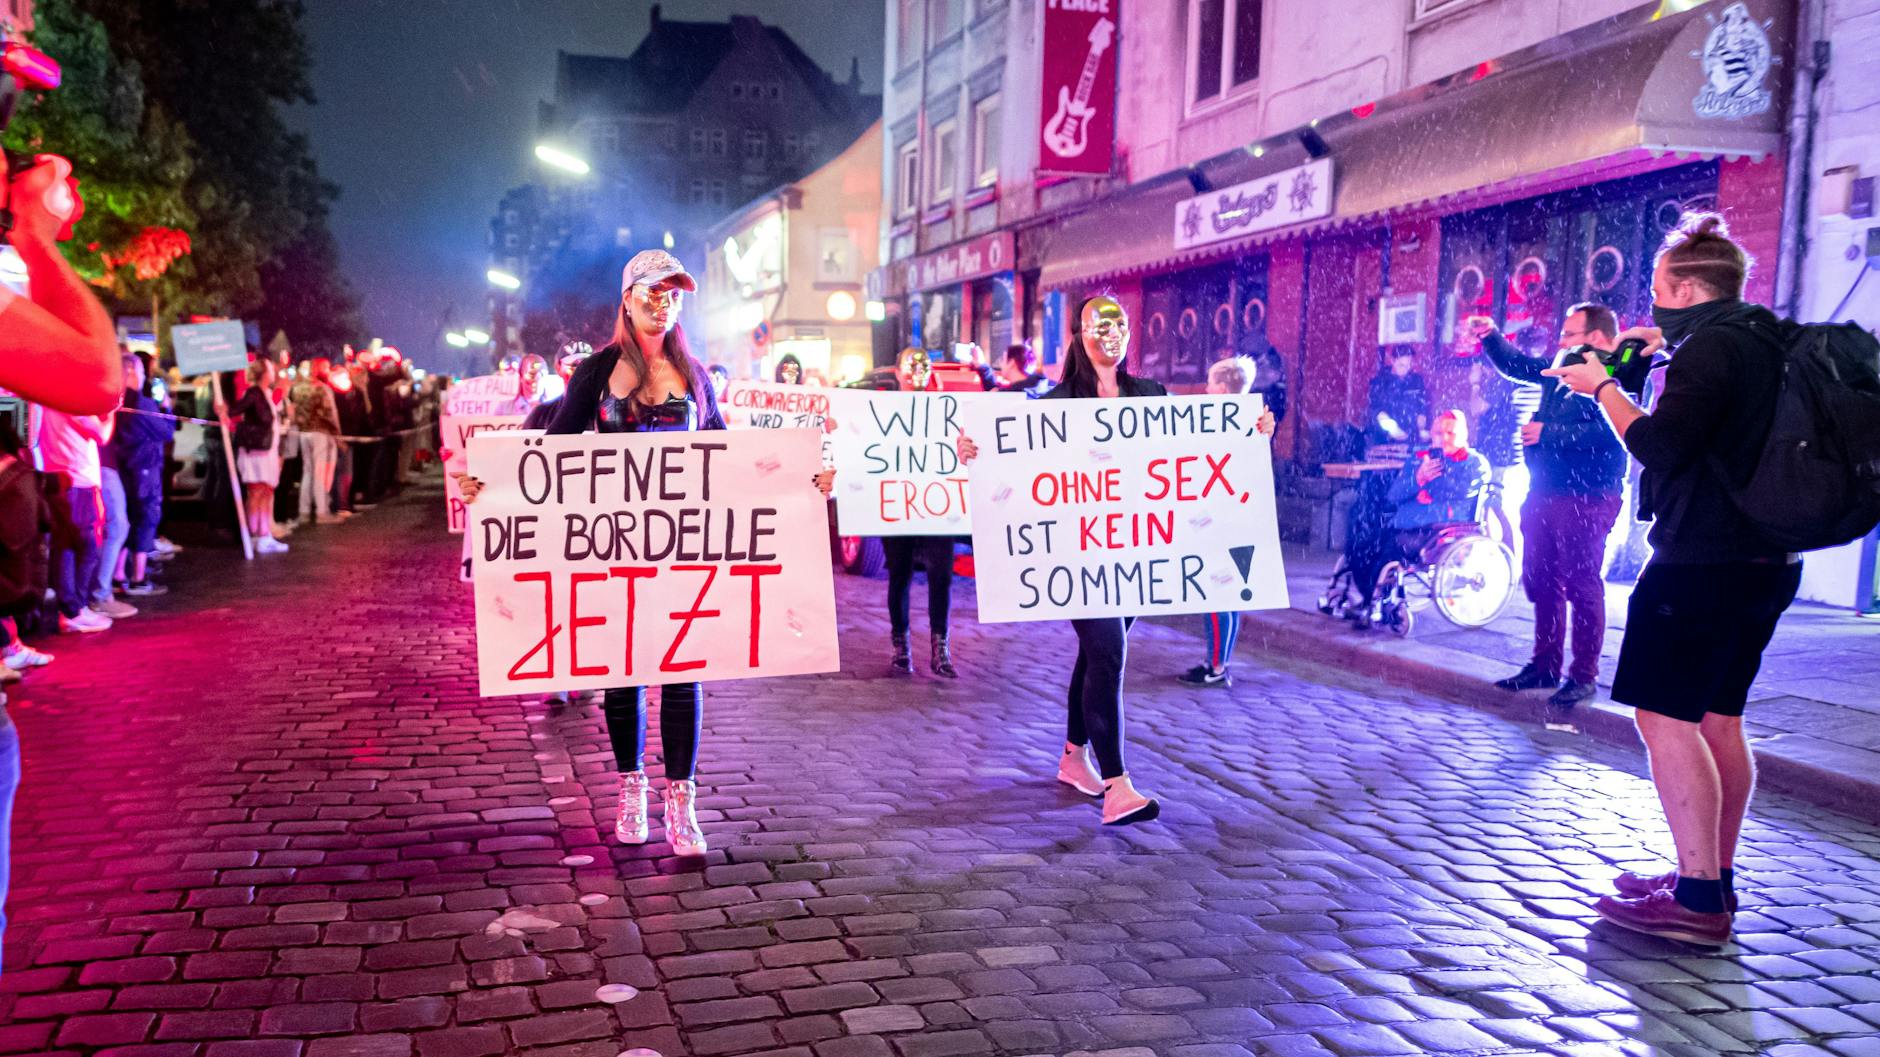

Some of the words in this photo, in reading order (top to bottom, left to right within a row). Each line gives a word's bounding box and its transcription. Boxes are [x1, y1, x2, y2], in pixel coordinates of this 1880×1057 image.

[454, 401, 491, 414] STEHT
[750, 413, 783, 429] WIRD
[869, 395, 961, 438] WIR
[995, 410, 1067, 454] EIN
[1093, 401, 1255, 442] SOMMER,
[518, 438, 727, 504] ÖFFNET
[864, 441, 958, 475] SIND
[1031, 468, 1121, 506] OHNE
[1144, 452, 1249, 504] SEX,
[480, 515, 538, 561] DIE
[564, 508, 777, 561] BORDELLE
[1006, 519, 1057, 556] IST
[1080, 510, 1174, 551] KEIN
[1019, 554, 1207, 608] SOMMER
[507, 564, 782, 681] JETZT
